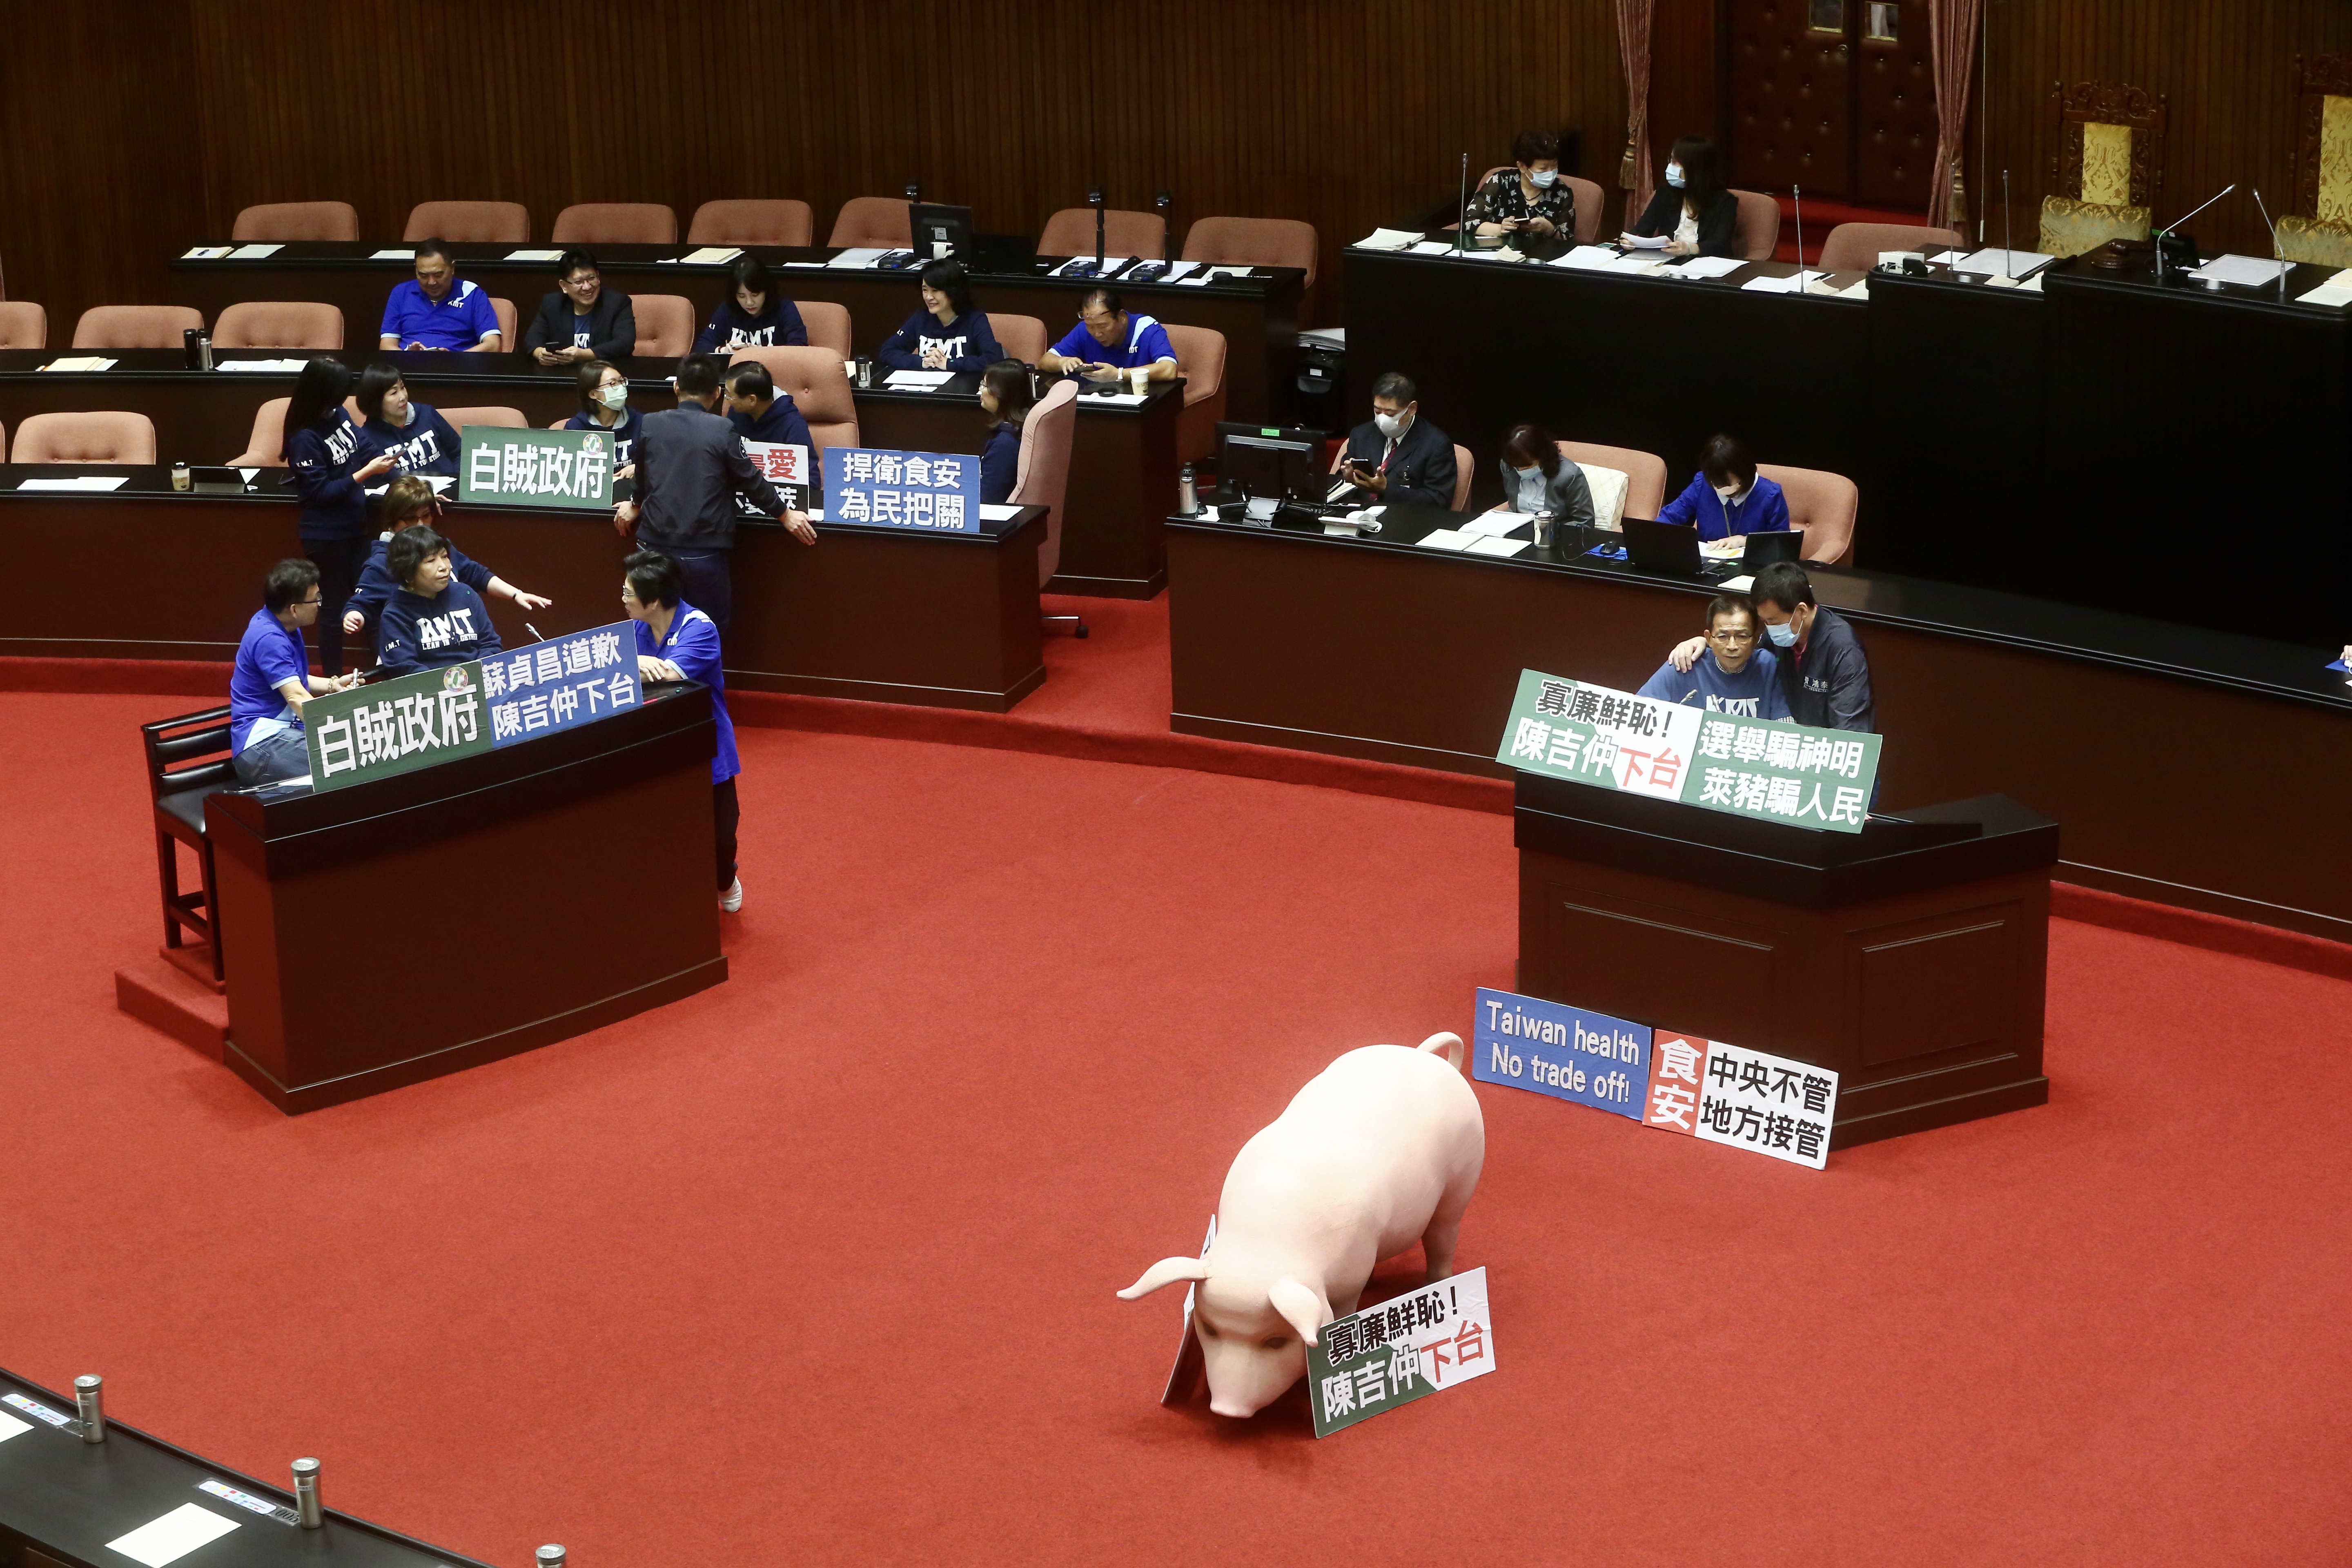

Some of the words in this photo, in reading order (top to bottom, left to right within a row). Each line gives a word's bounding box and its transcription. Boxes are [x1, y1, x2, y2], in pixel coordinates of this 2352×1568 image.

[732, 326, 775, 347] KMT
[919, 335, 967, 359] KMT
[324, 420, 358, 461] KMT
[470, 442, 608, 499] 白賊政府
[843, 452, 961, 489] 捍衛食安
[838, 488, 964, 530] 為民把關
[385, 639, 400, 653] K.M.T
[416, 608, 474, 644] KMT
[422, 640, 440, 650] LEAN
[481, 632, 620, 699] 蘇貞昌道歉
[317, 684, 479, 778] 白賊政府
[492, 673, 635, 741] 陳吉仲下台
[1536, 680, 1673, 738] 寡廉鮮恥！
[1706, 695, 1760, 718] KMT
[1510, 717, 1682, 789] 陳吉仲下台
[1698, 719, 1864, 779] 選舉騙神明
[1699, 766, 1864, 826] 萊豬騙人民
[1486, 1000, 1566, 1047] Taiwan
[1574, 1020, 1640, 1065] health
[1491, 1042, 1523, 1078] No
[1531, 1054, 1586, 1093] trade
[1593, 1070, 1630, 1103] off!
[1652, 1038, 1703, 1130] 食安
[1708, 1053, 1832, 1114] 中央不管
[1700, 1095, 1825, 1160] 地方接管
[1327, 1285, 1457, 1365] 寡廉鮮恥！
[1321, 1320, 1484, 1423] 陳吉仲下台
